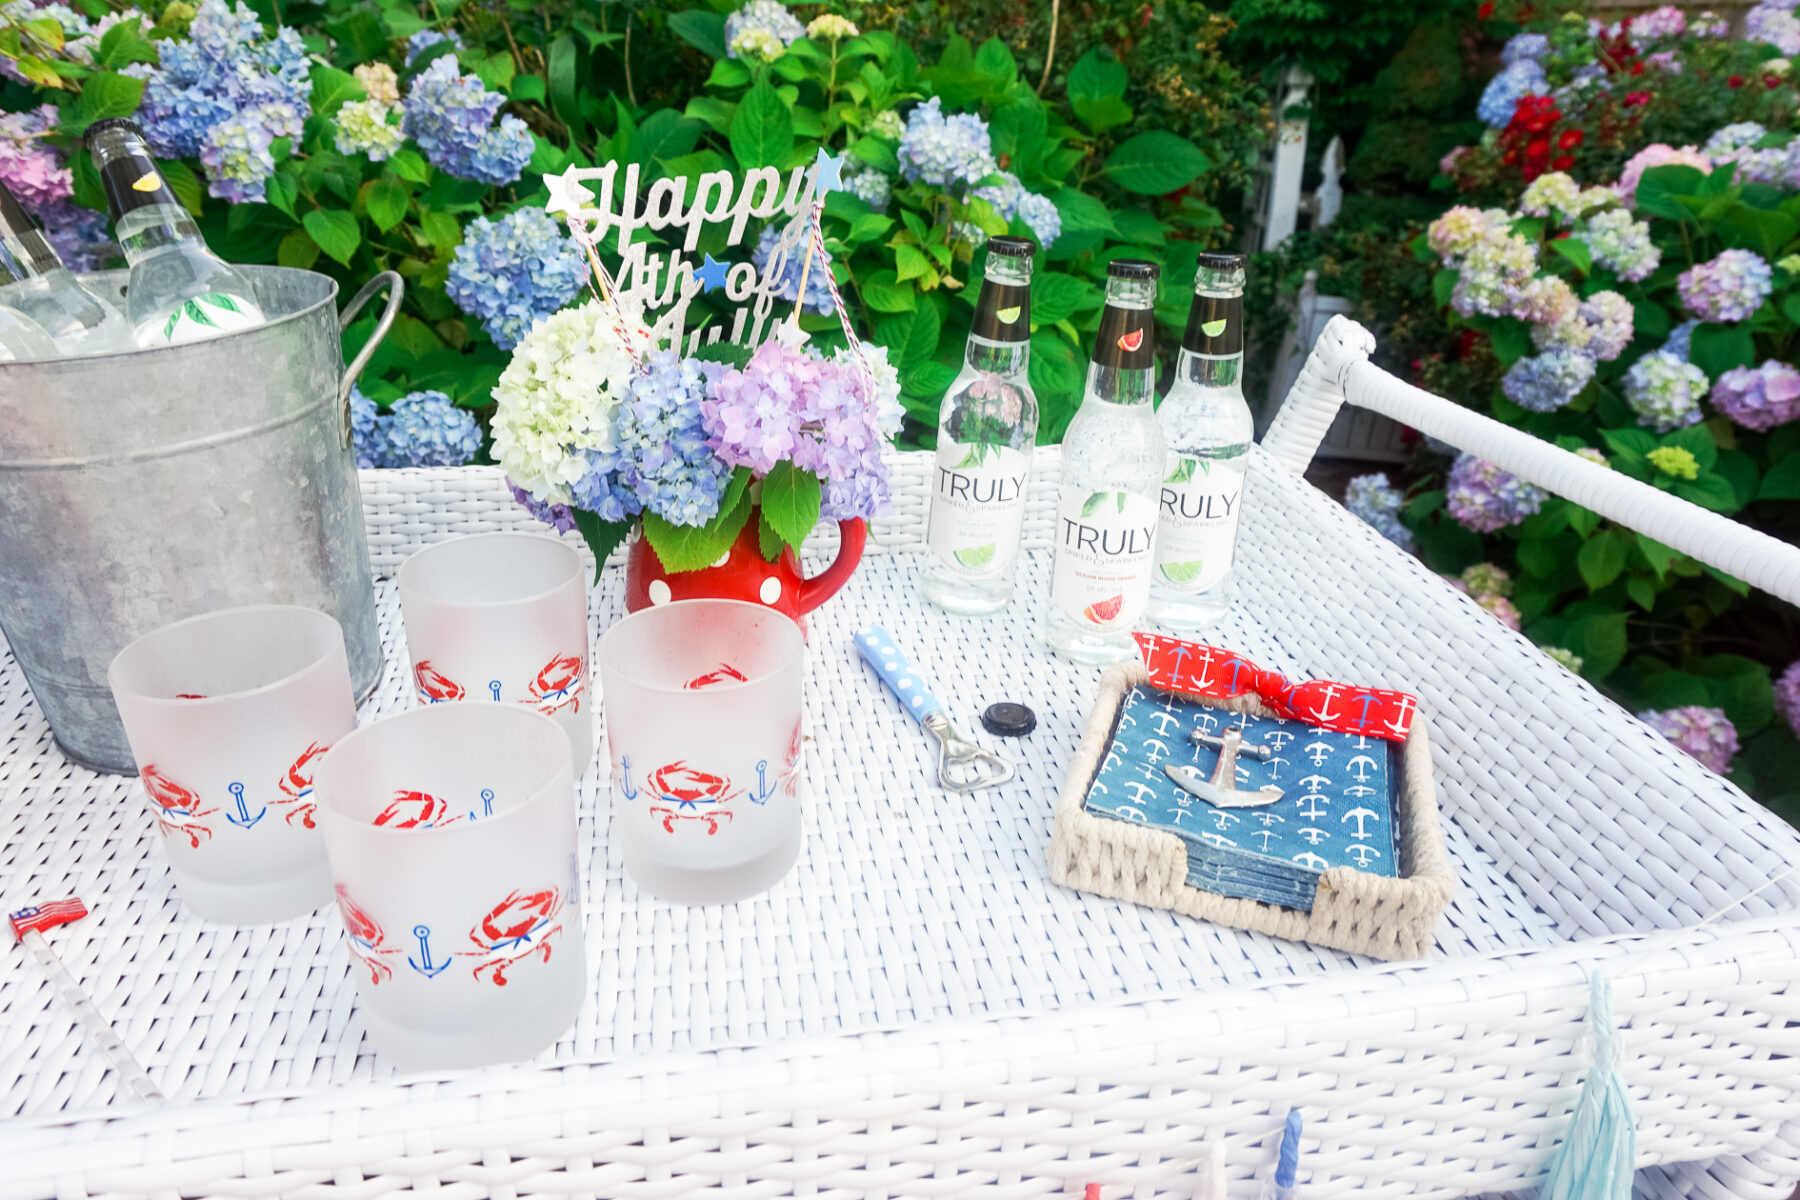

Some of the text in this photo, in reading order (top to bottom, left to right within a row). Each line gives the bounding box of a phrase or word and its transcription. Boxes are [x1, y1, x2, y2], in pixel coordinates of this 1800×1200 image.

[563, 158, 822, 257] Happy
[614, 241, 790, 321] 4th of
[938, 465, 1027, 503] TRULY
[1158, 487, 1239, 519] RULY
[1063, 516, 1156, 556] TRULY
